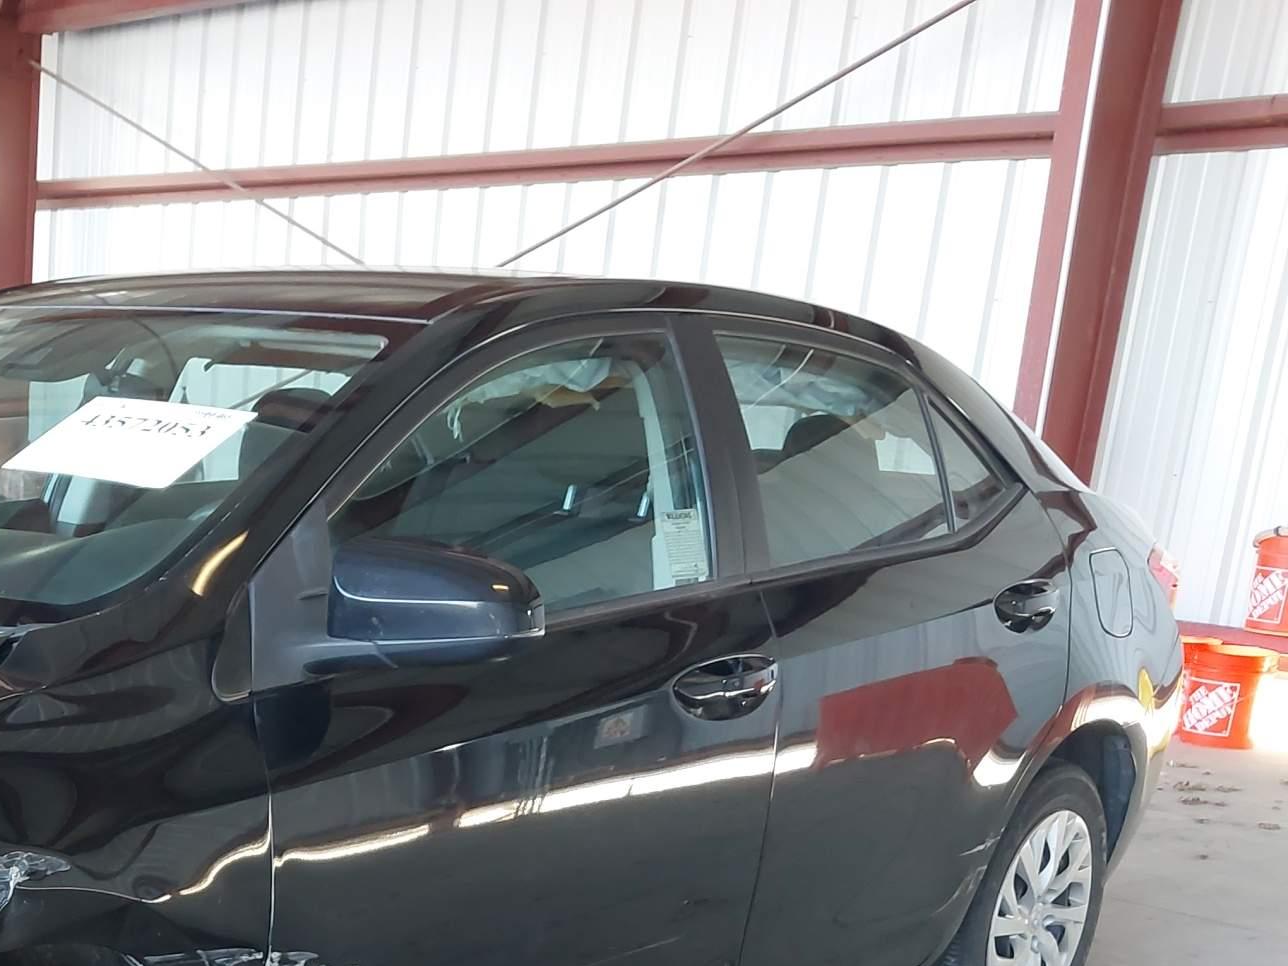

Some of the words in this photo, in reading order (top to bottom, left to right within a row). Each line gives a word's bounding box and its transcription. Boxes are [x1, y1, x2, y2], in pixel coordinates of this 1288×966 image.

[80, 413, 212, 438] 43572053
[1183, 684, 1236, 730] HOME
[1194, 703, 1232, 731] DEPOT
